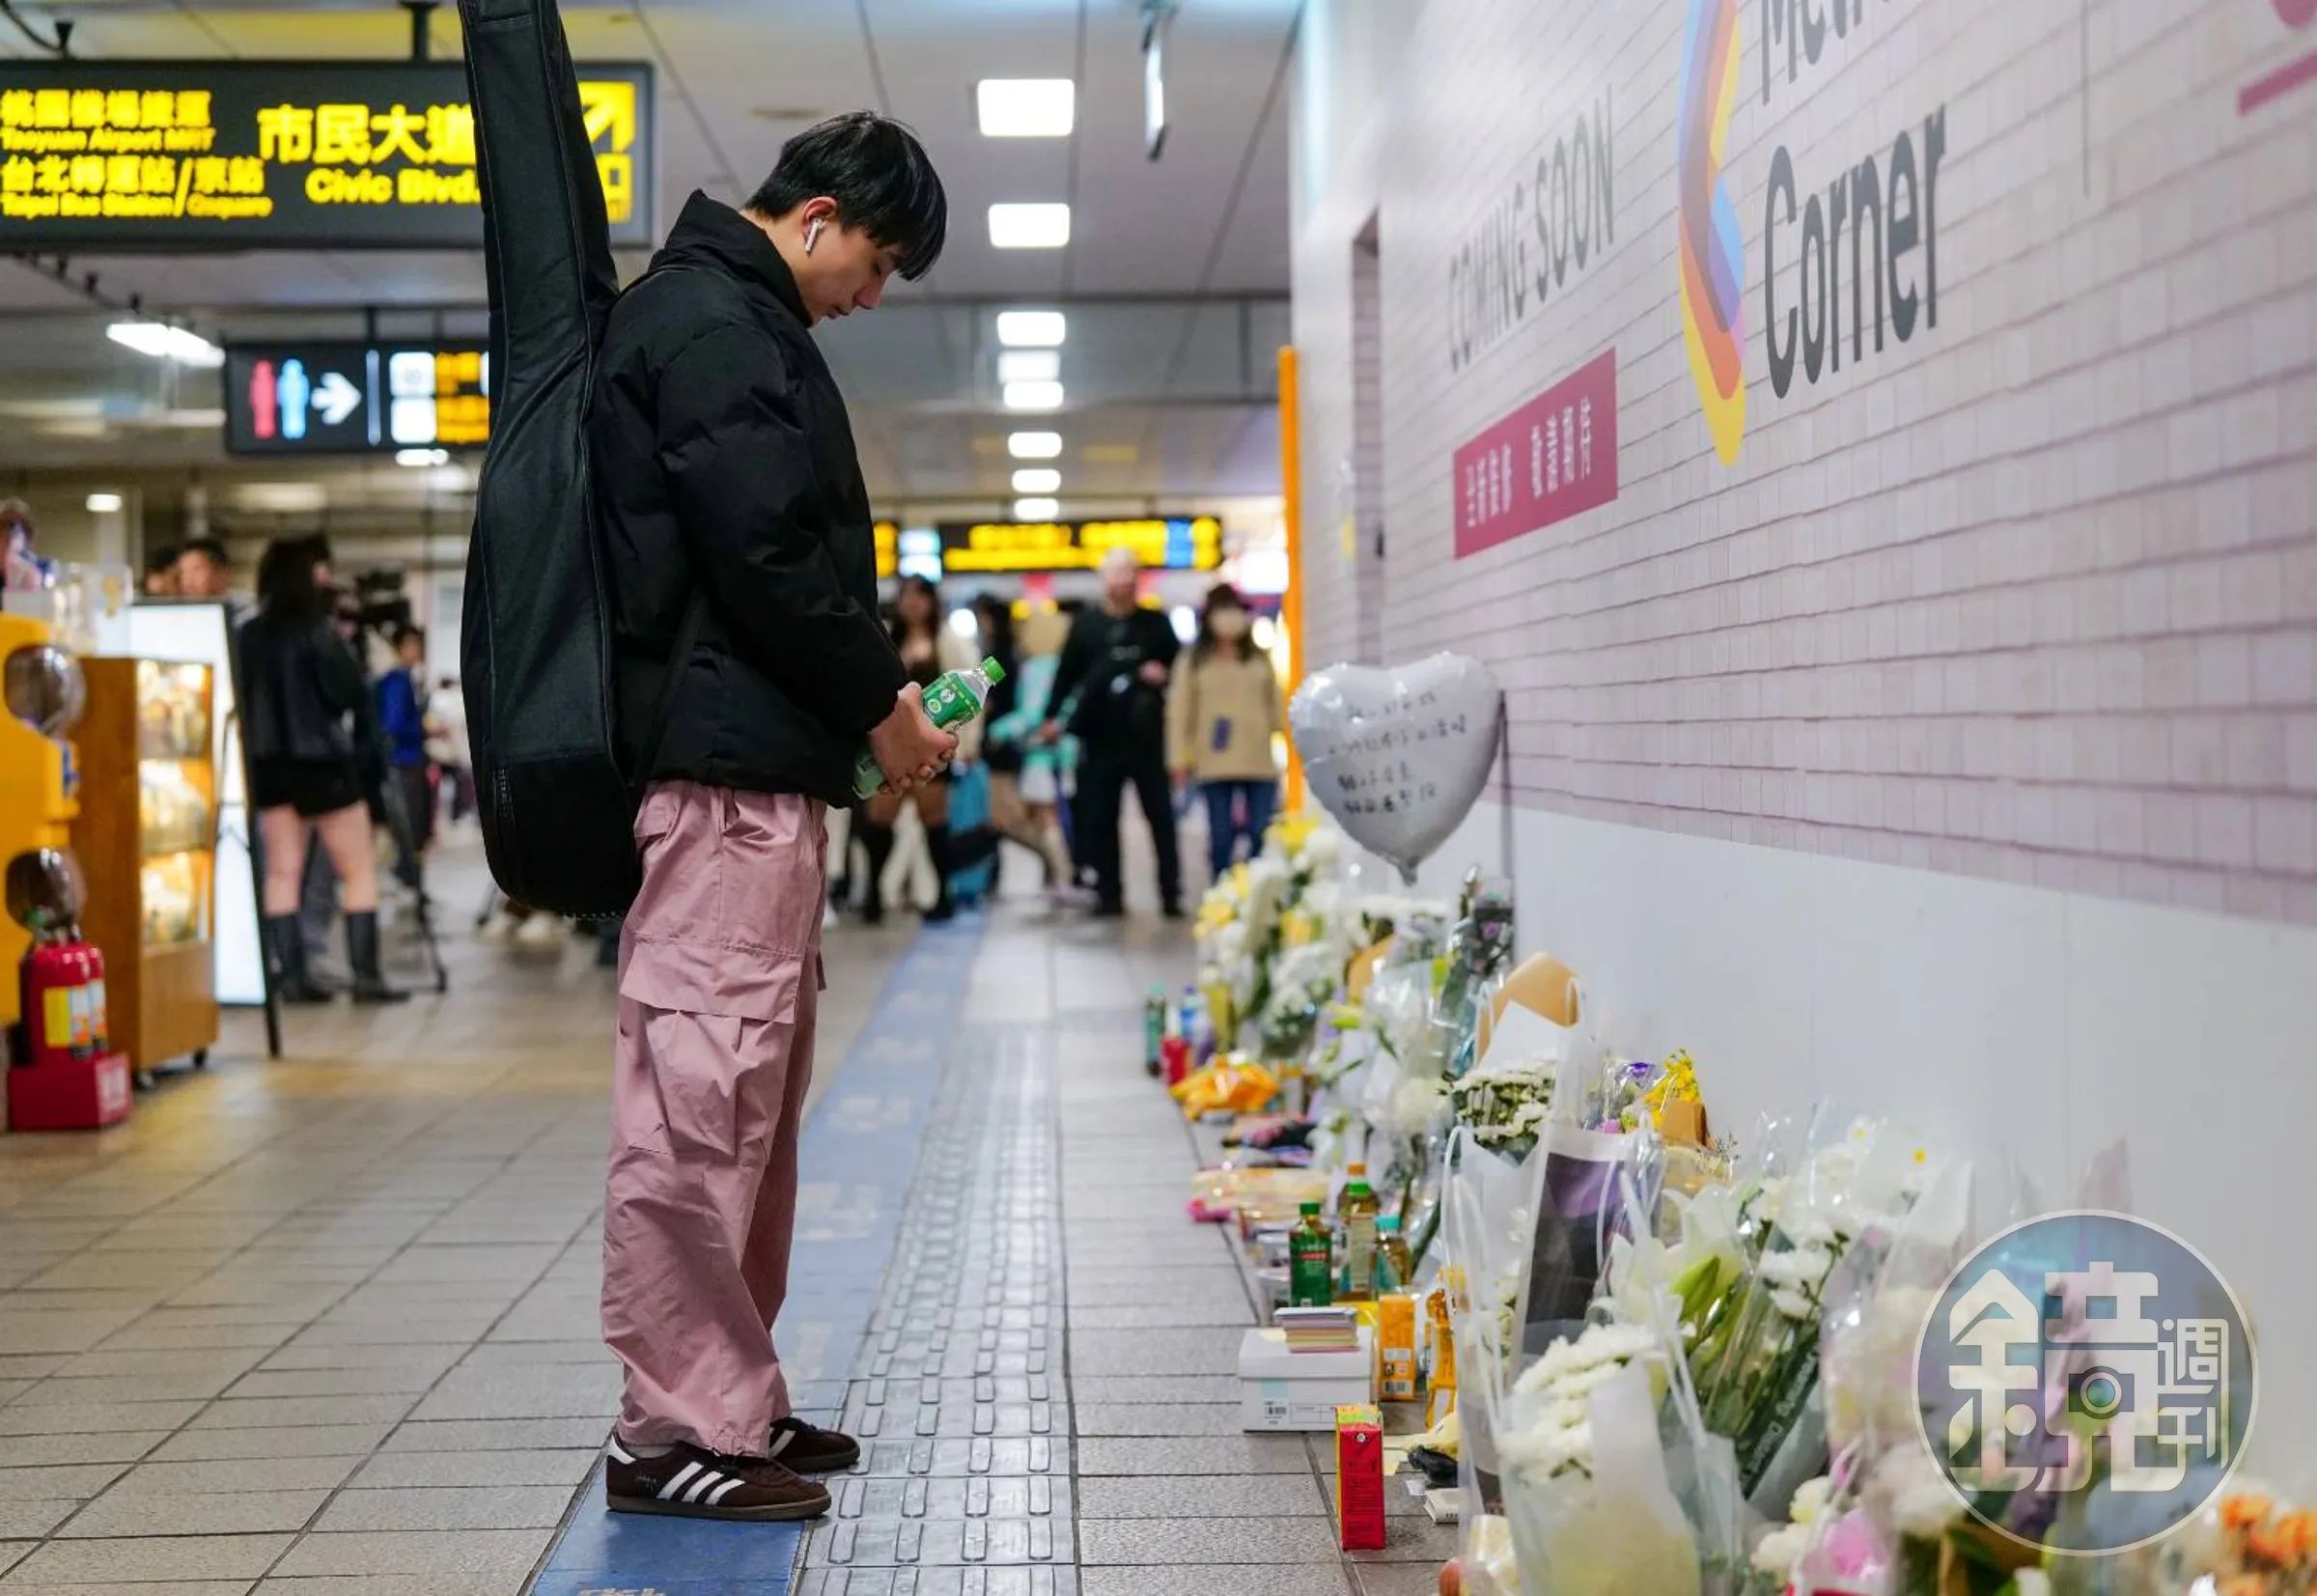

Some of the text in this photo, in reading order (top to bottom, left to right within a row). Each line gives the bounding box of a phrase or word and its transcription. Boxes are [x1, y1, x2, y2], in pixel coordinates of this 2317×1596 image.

[305, 168, 394, 204] Civic
[1535, 83, 1615, 303] SOON
[1765, 103, 1946, 399] Corner
